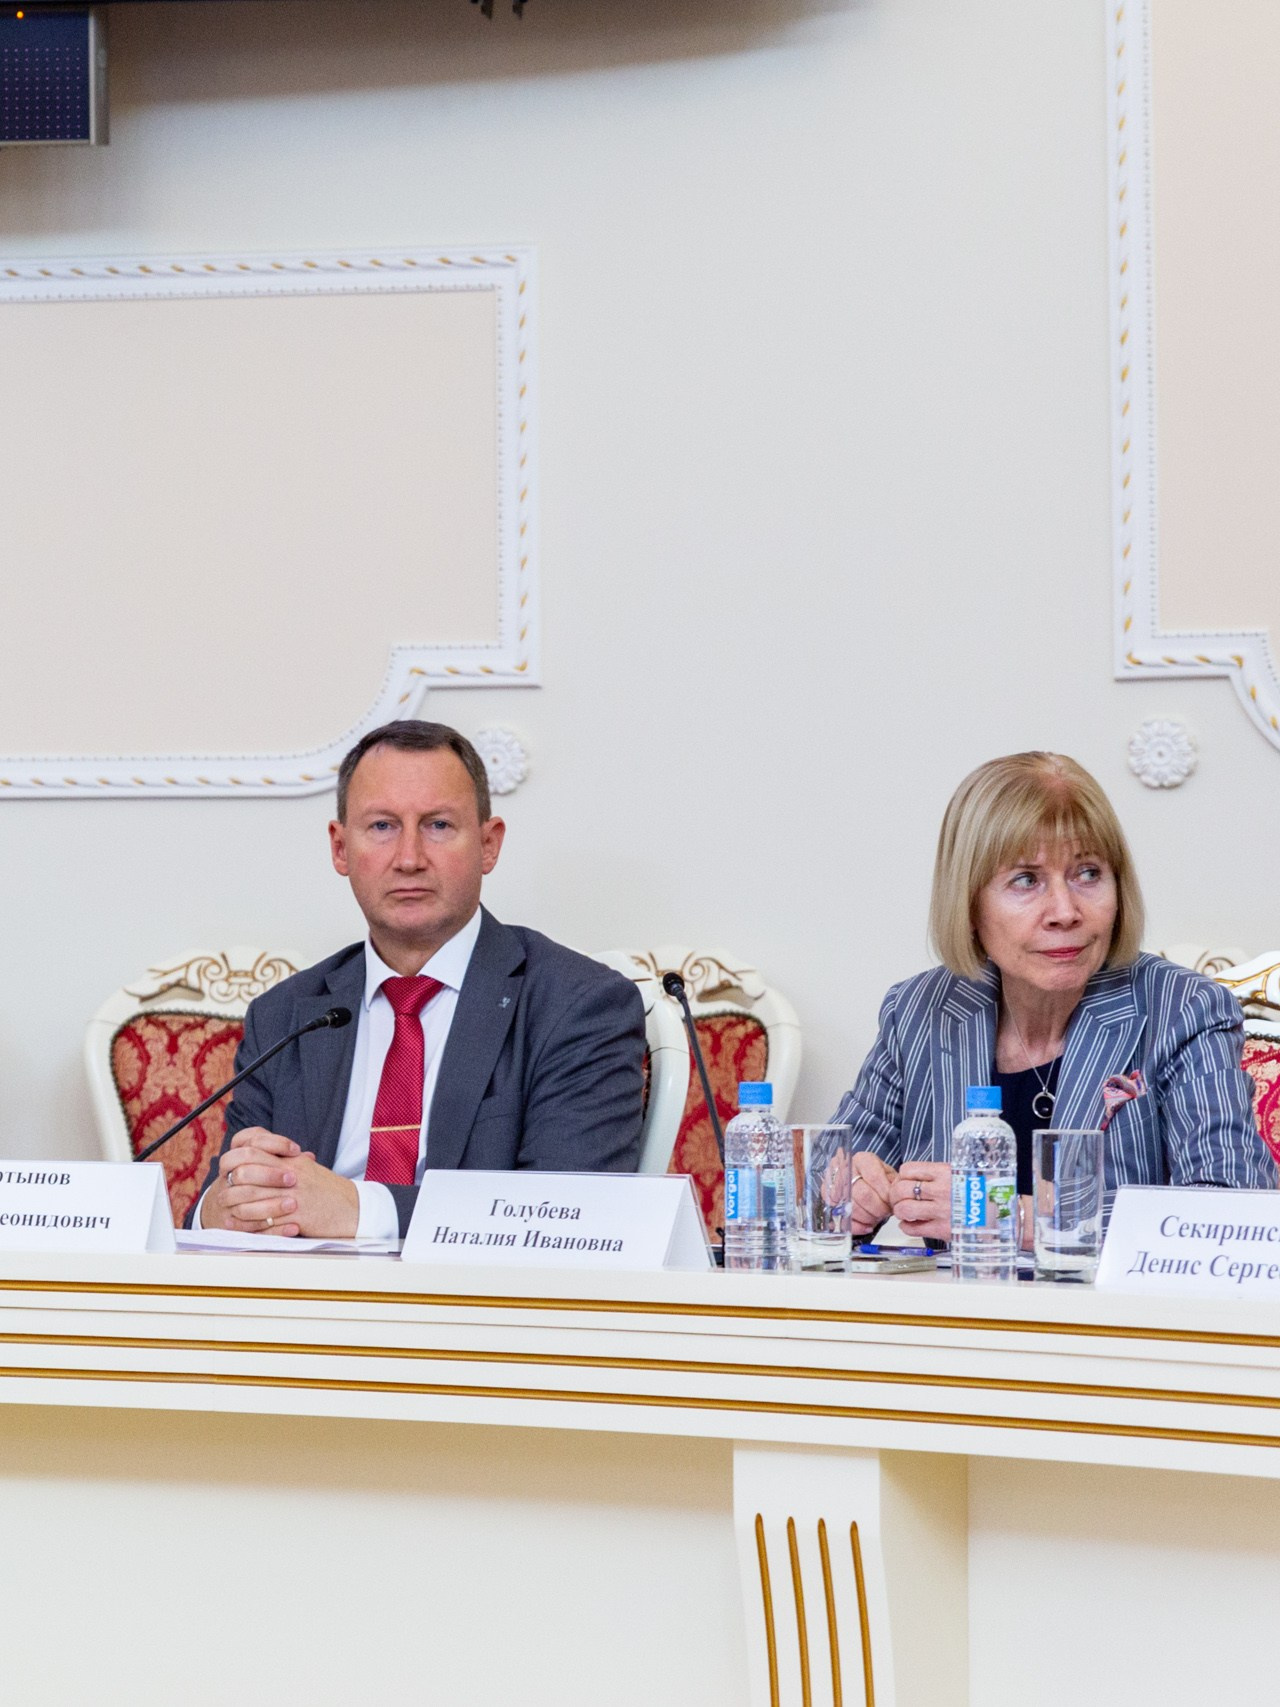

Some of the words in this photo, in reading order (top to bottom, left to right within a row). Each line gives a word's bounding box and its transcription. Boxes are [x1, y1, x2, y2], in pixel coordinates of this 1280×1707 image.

[727, 1170, 737, 1217] Vorgol
[968, 1176, 984, 1225] Vorgol
[488, 1199, 582, 1222] Голубева
[431, 1226, 516, 1248] Наталия
[522, 1229, 624, 1252] Ивановна
[1160, 1215, 1280, 1246] Секиринс
[1126, 1250, 1202, 1277] Денис
[1209, 1254, 1280, 1284] Серге
